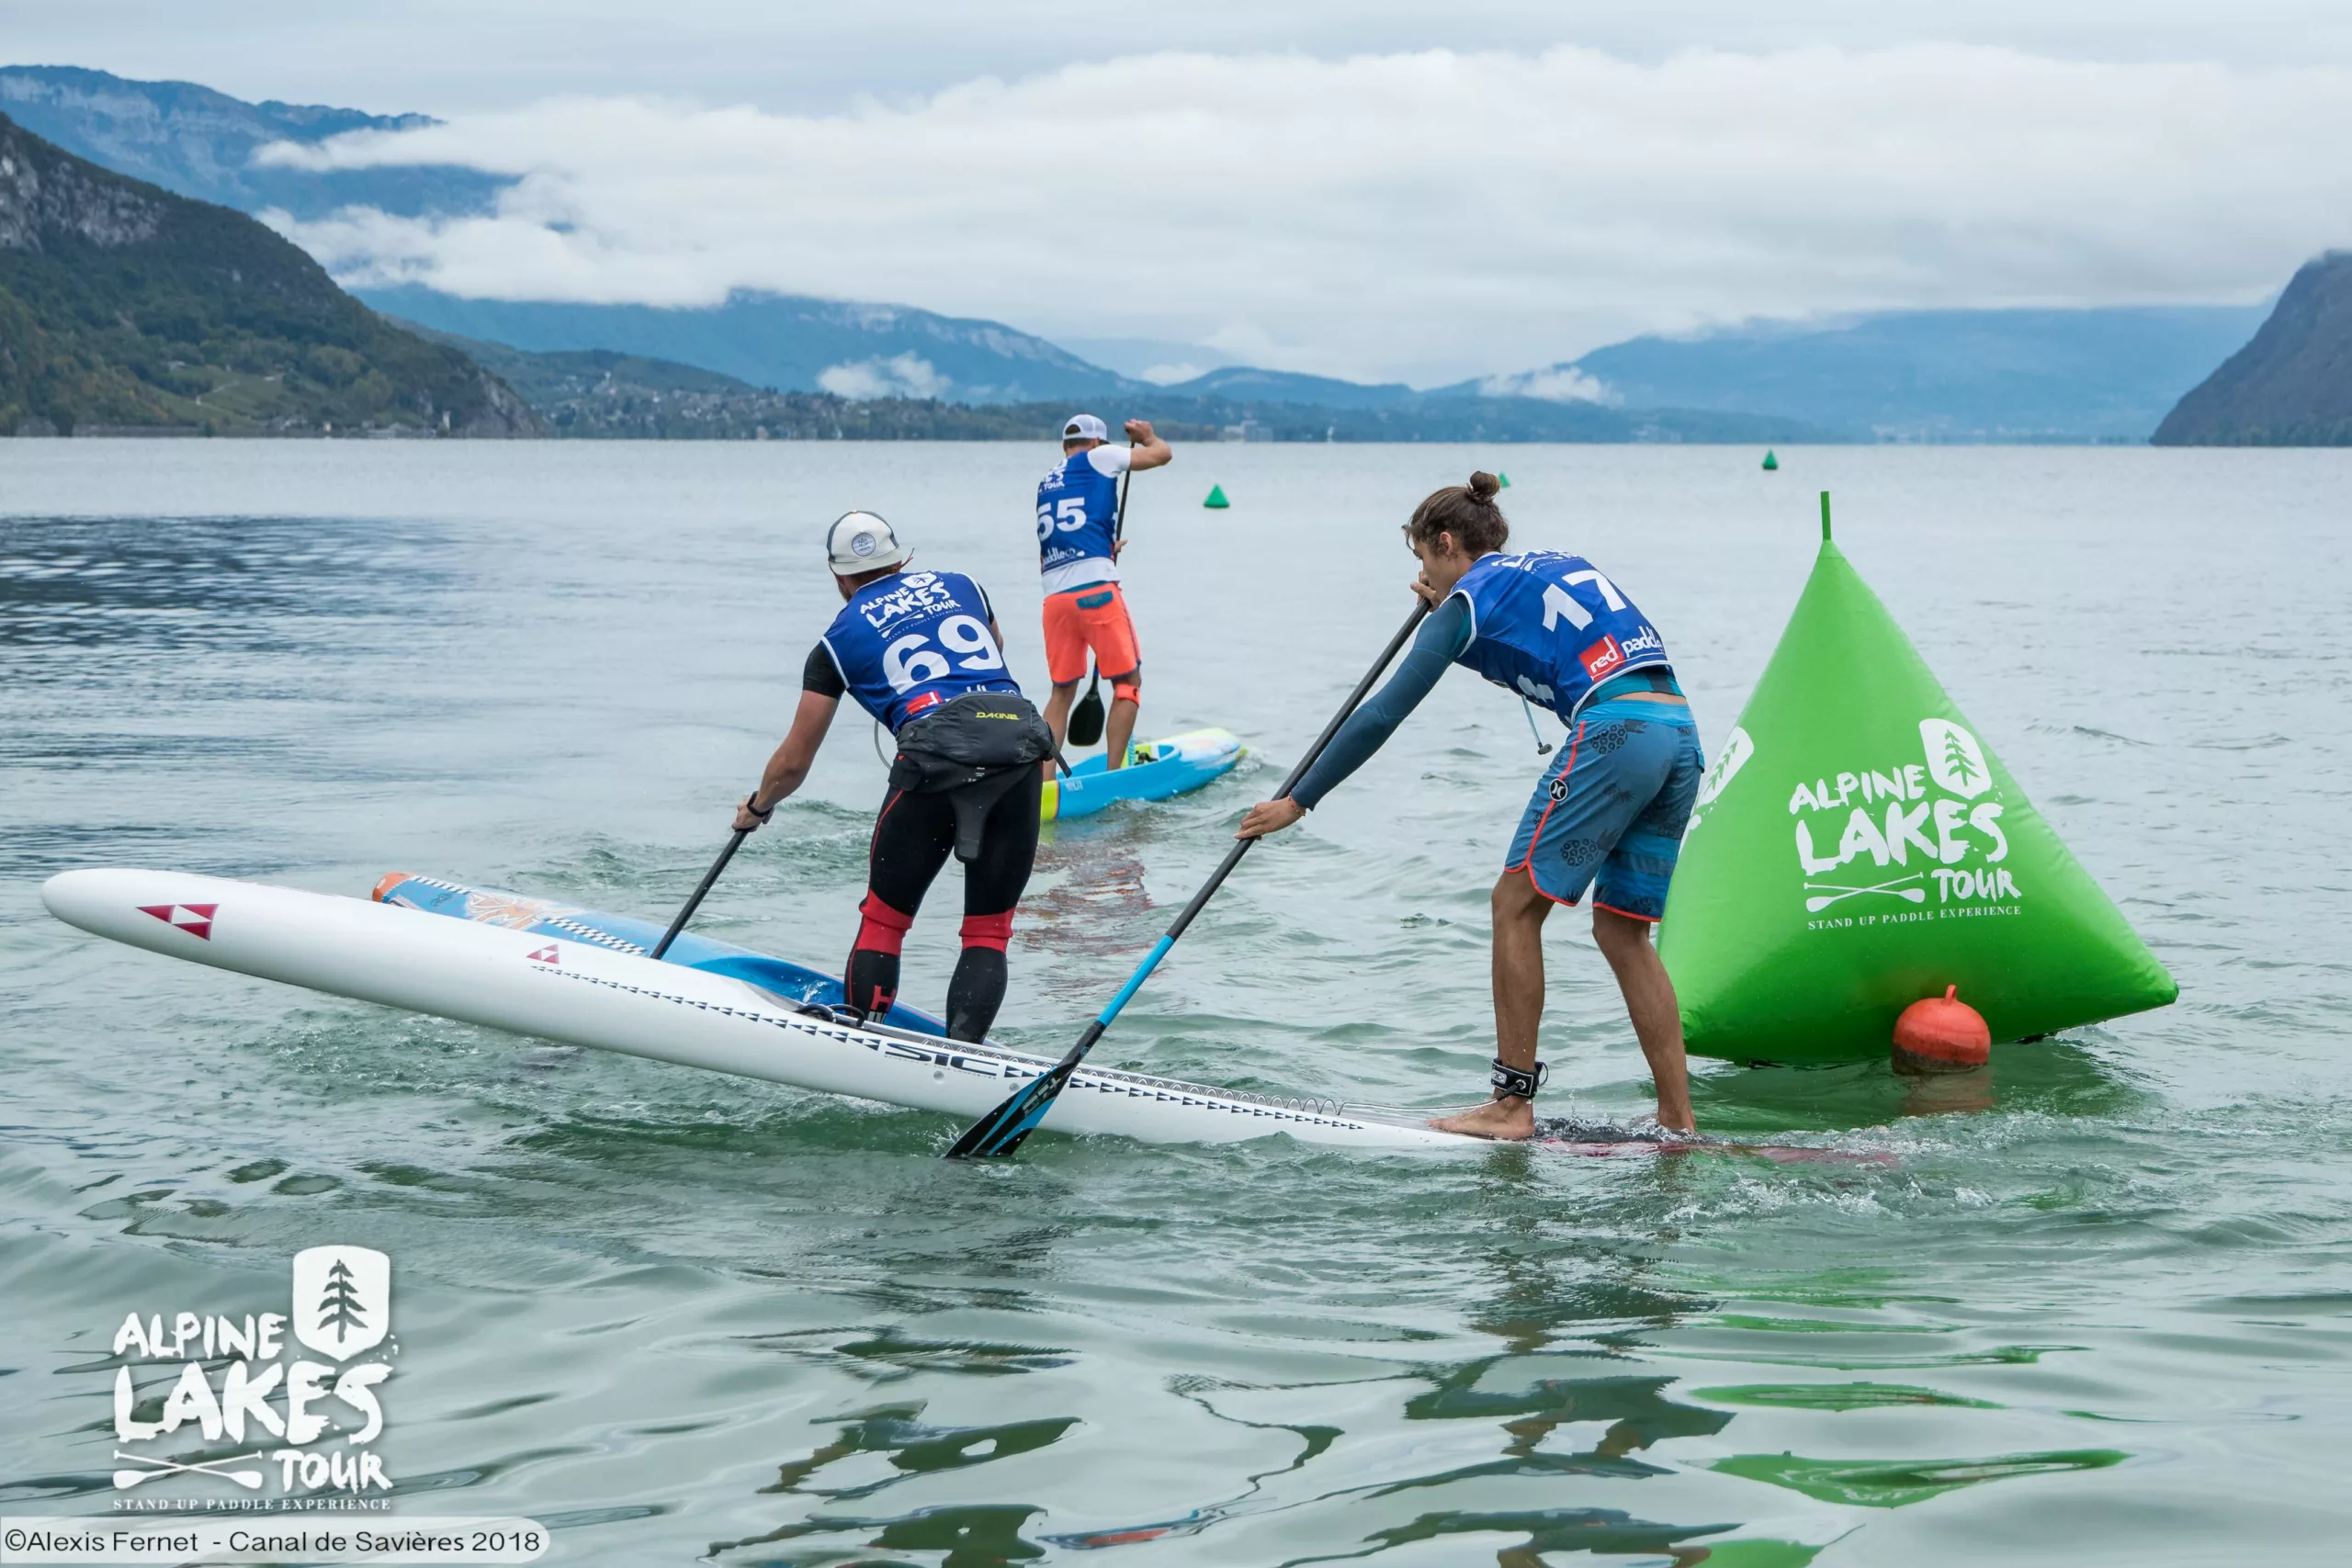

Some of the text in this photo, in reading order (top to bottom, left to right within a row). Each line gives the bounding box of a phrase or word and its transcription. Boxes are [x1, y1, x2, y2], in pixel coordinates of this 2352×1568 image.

[1038, 497, 1087, 542] 55
[860, 586, 910, 615] ALPINE
[865, 581, 951, 628] LAKES
[923, 599, 962, 615] TOUR
[1543, 570, 1627, 632] 17
[882, 615, 1003, 695] 69
[1589, 636, 1619, 673] red
[975, 711, 1020, 720] DAKINE
[1789, 764, 1927, 815] ALPINE
[1795, 798, 2008, 876] LAKES
[1930, 867, 2022, 903] TOUR
[1808, 906, 2022, 930] STAND UP PADDLE EXPERIENCE
